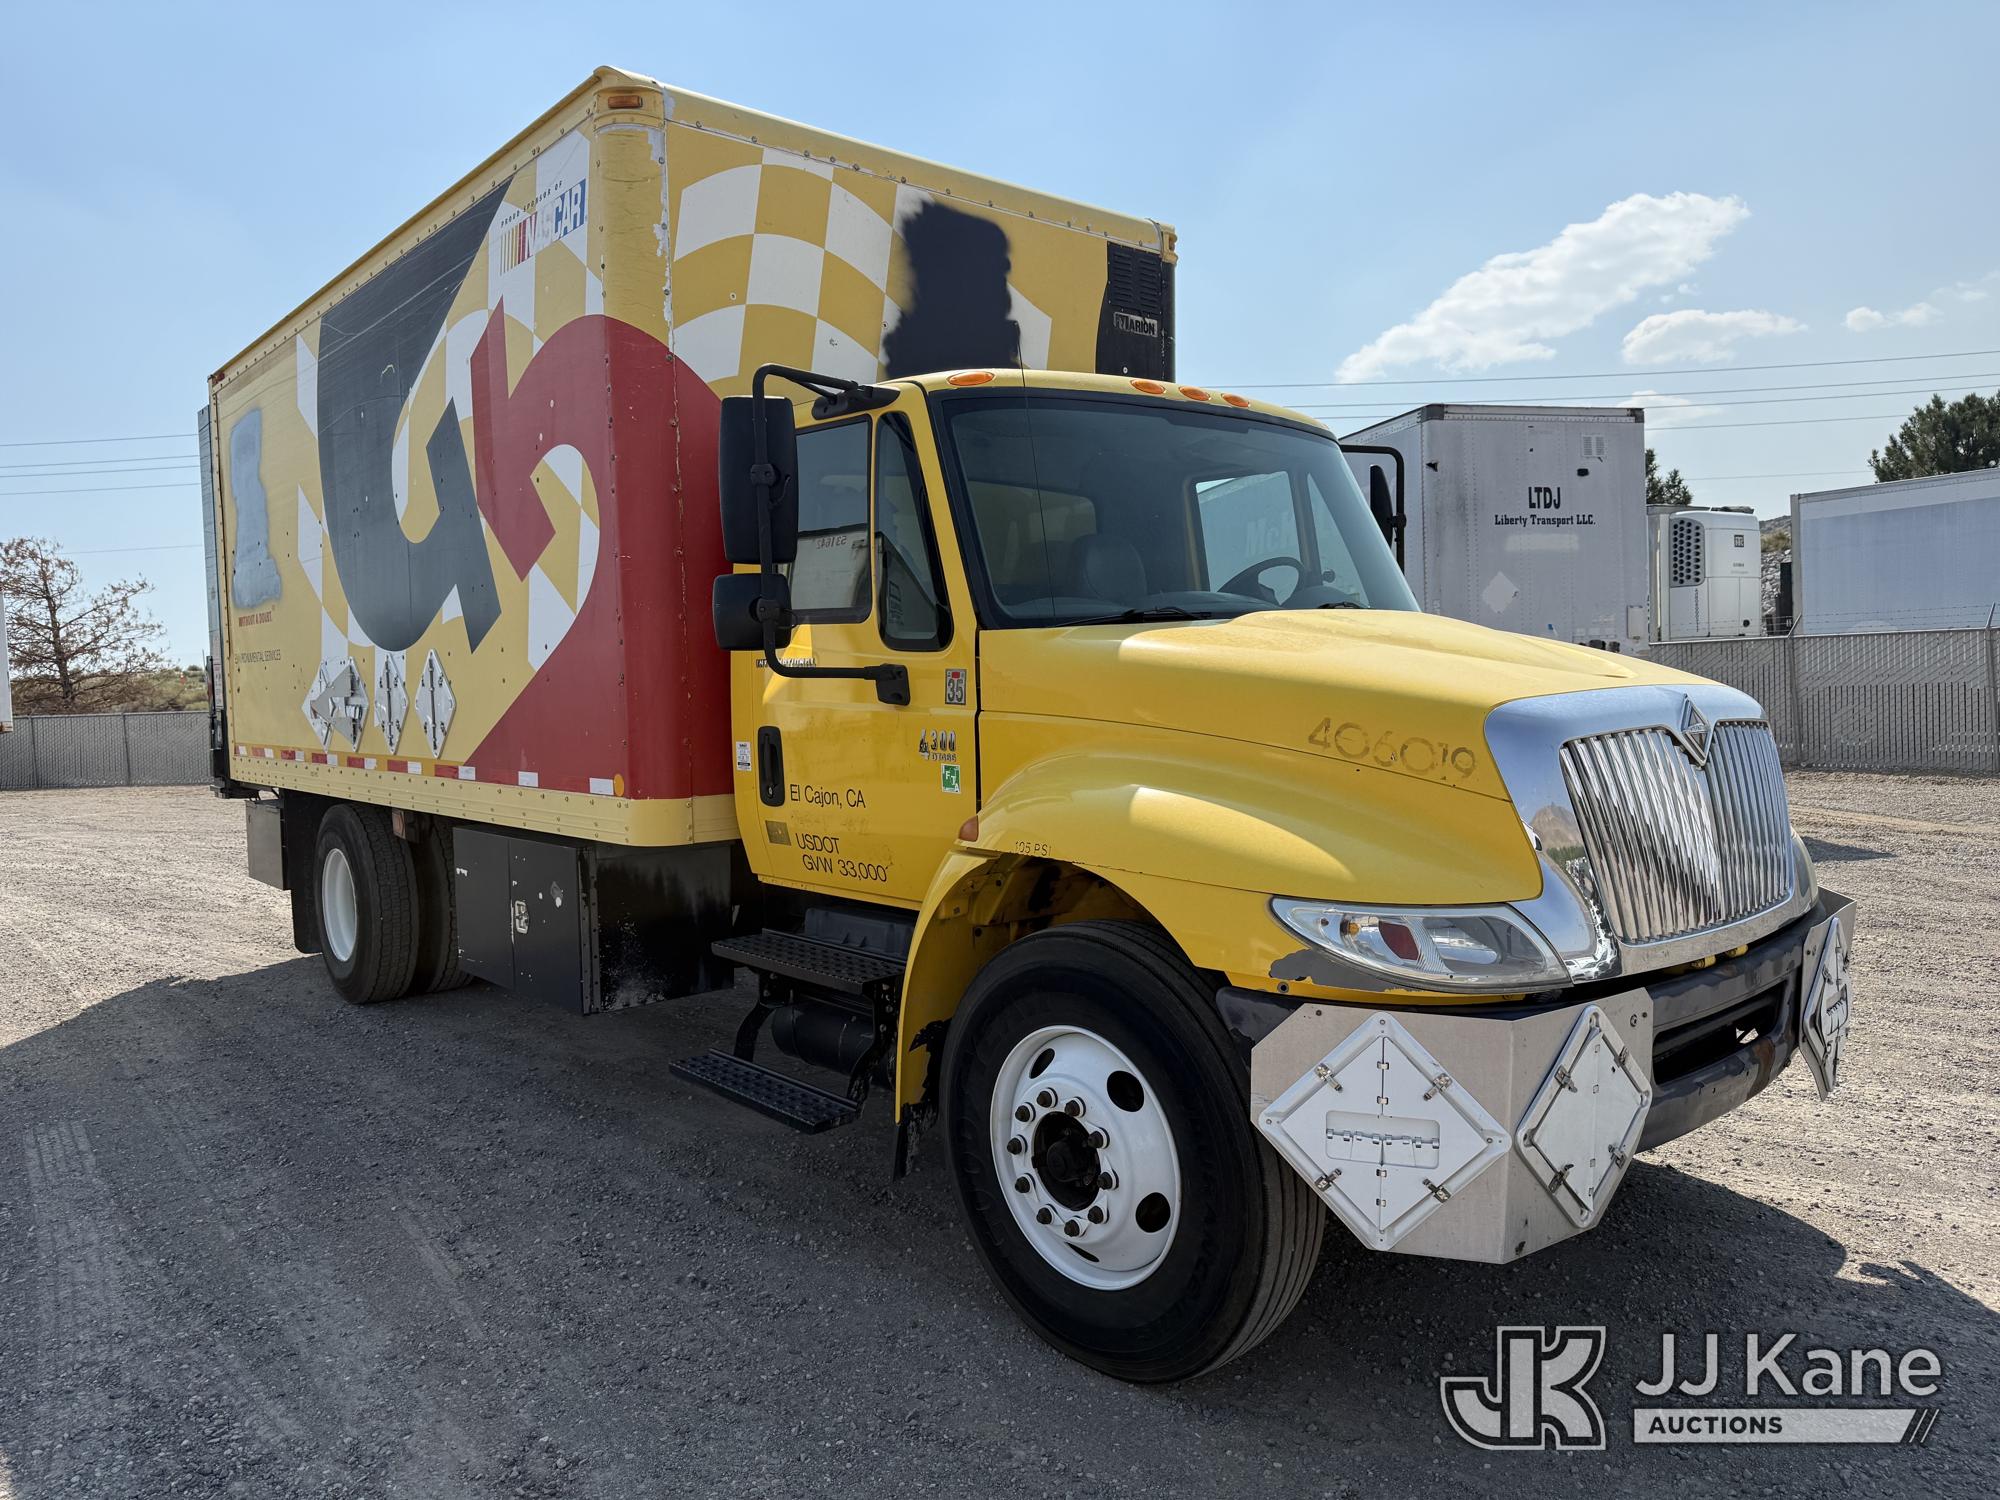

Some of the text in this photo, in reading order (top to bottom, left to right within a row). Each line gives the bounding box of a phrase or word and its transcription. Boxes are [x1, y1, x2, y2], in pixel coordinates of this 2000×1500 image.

[554, 180, 563, 191] OF
[1528, 486, 1561, 509] LTDJ
[1494, 514, 1596, 527] Liberty Transport LLC.
[947, 679, 964, 702] 35
[1308, 717, 1477, 779] 406019
[790, 784, 866, 809] El Cajon, CA
[795, 833, 840, 854] USDOT
[802, 854, 888, 882] GVW 33,000
